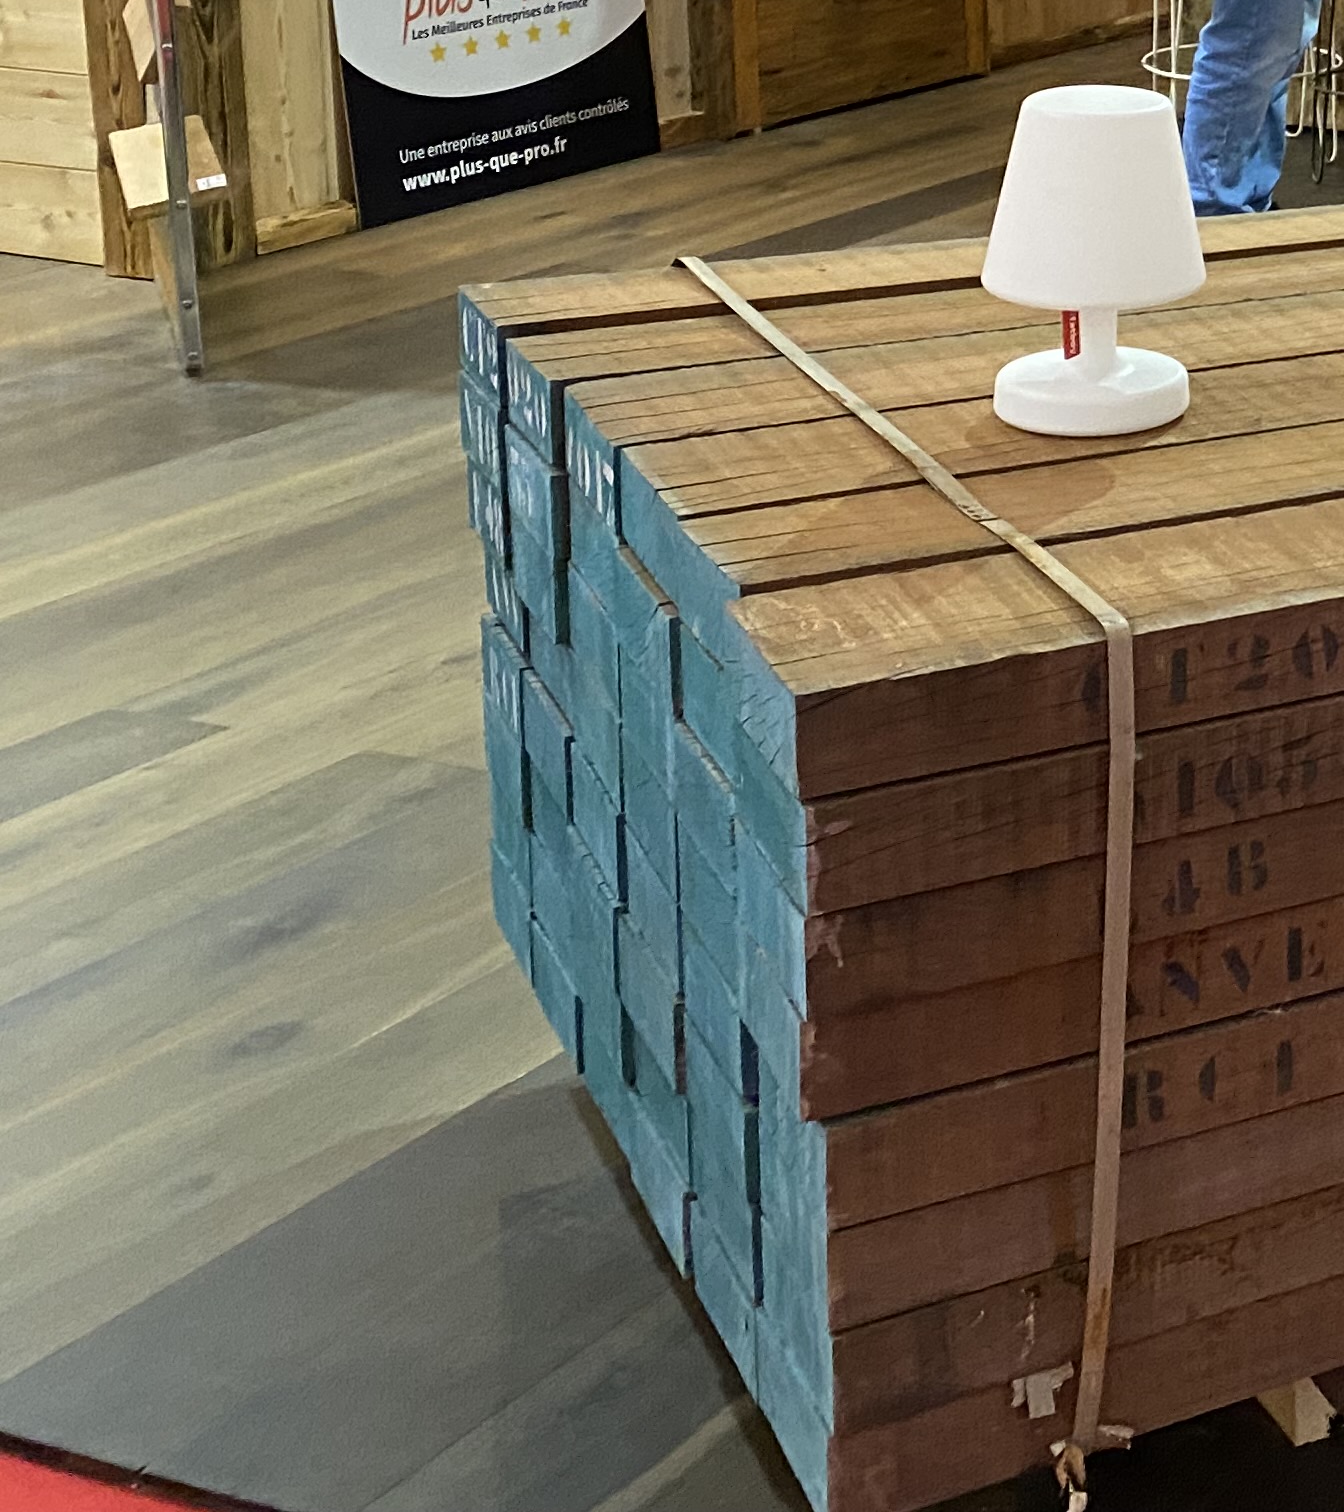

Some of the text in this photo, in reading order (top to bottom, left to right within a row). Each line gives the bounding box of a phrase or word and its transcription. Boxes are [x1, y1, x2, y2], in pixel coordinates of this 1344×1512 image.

[411, 27, 430, 41] Les
[431, 17, 484, 38] Meilleures
[486, 6, 542, 27] Entreprises
[543, 2, 556, 15] de
[399, 96, 630, 165] Une entreprise aux avis clients contrôlés
[402, 136, 568, 192] www.plus-que-pro.fr
